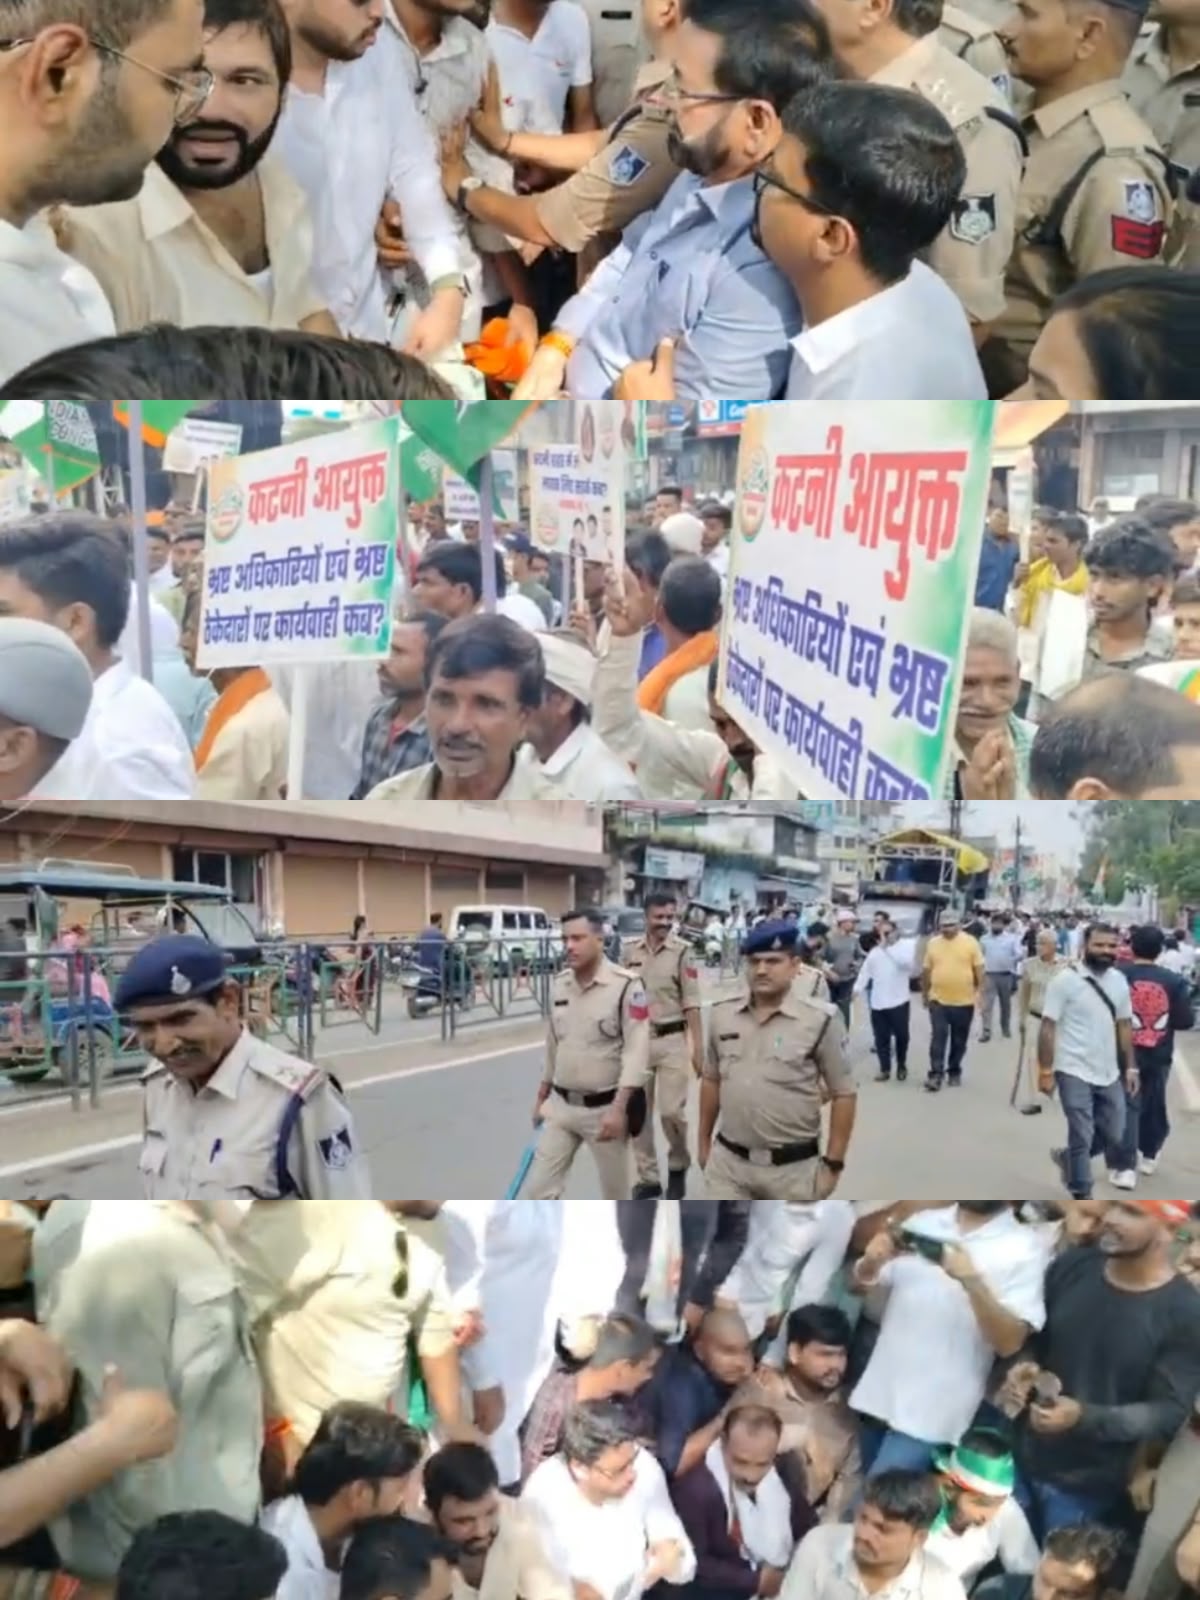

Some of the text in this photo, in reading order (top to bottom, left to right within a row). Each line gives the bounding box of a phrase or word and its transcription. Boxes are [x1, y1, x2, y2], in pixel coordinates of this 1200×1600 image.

[248, 456, 308, 524] कटनी
[313, 452, 388, 529] आयुक्त
[771, 425, 968, 602] कटनी आयुक्त
[235, 543, 323, 592] अधिकारियों
[325, 538, 351, 582] एवं
[354, 544, 388, 583] भ्रष्ट
[253, 612, 273, 641] पर
[274, 596, 340, 641] कार्यवाही
[343, 603, 385, 637] कब?
[752, 575, 848, 678] अधिकारियों
[846, 615, 886, 698] एवं
[889, 643, 949, 730] भ्रष्ट
[763, 678, 784, 734] पर
[784, 691, 863, 800] कार्यवाही
